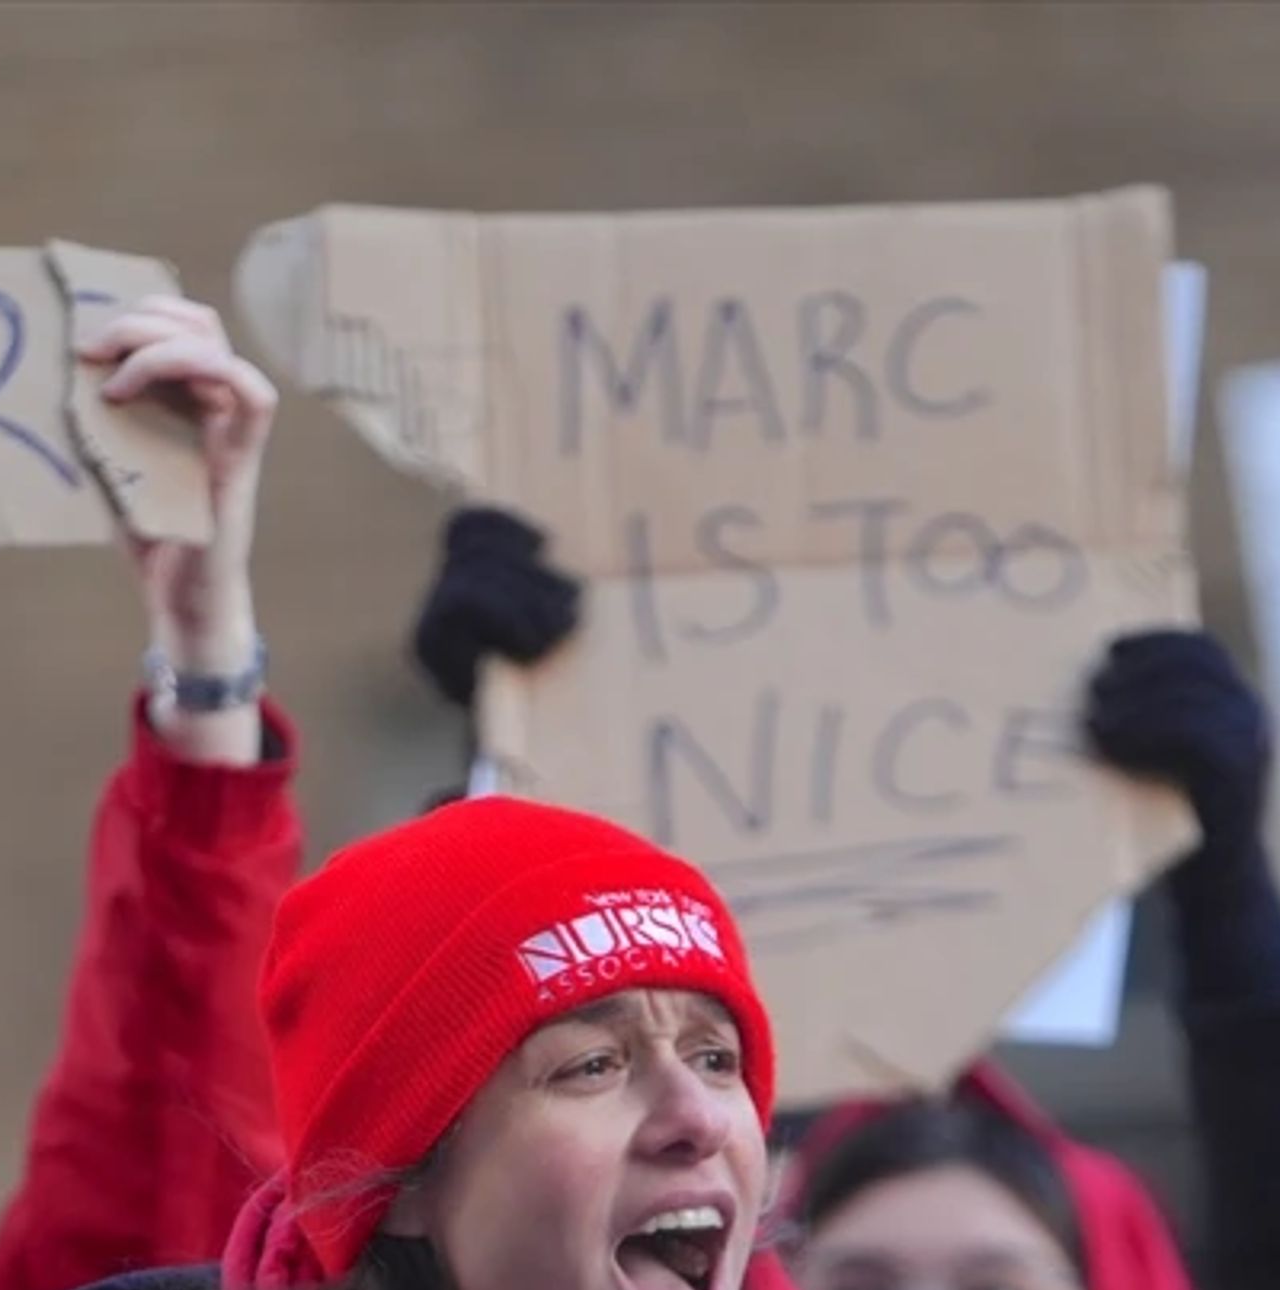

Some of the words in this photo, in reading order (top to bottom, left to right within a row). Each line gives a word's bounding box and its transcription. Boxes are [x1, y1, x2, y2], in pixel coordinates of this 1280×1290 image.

[556, 292, 999, 460] MARC
[623, 505, 781, 662] IS
[807, 498, 1091, 630] TOO
[646, 682, 1082, 846] NICE
